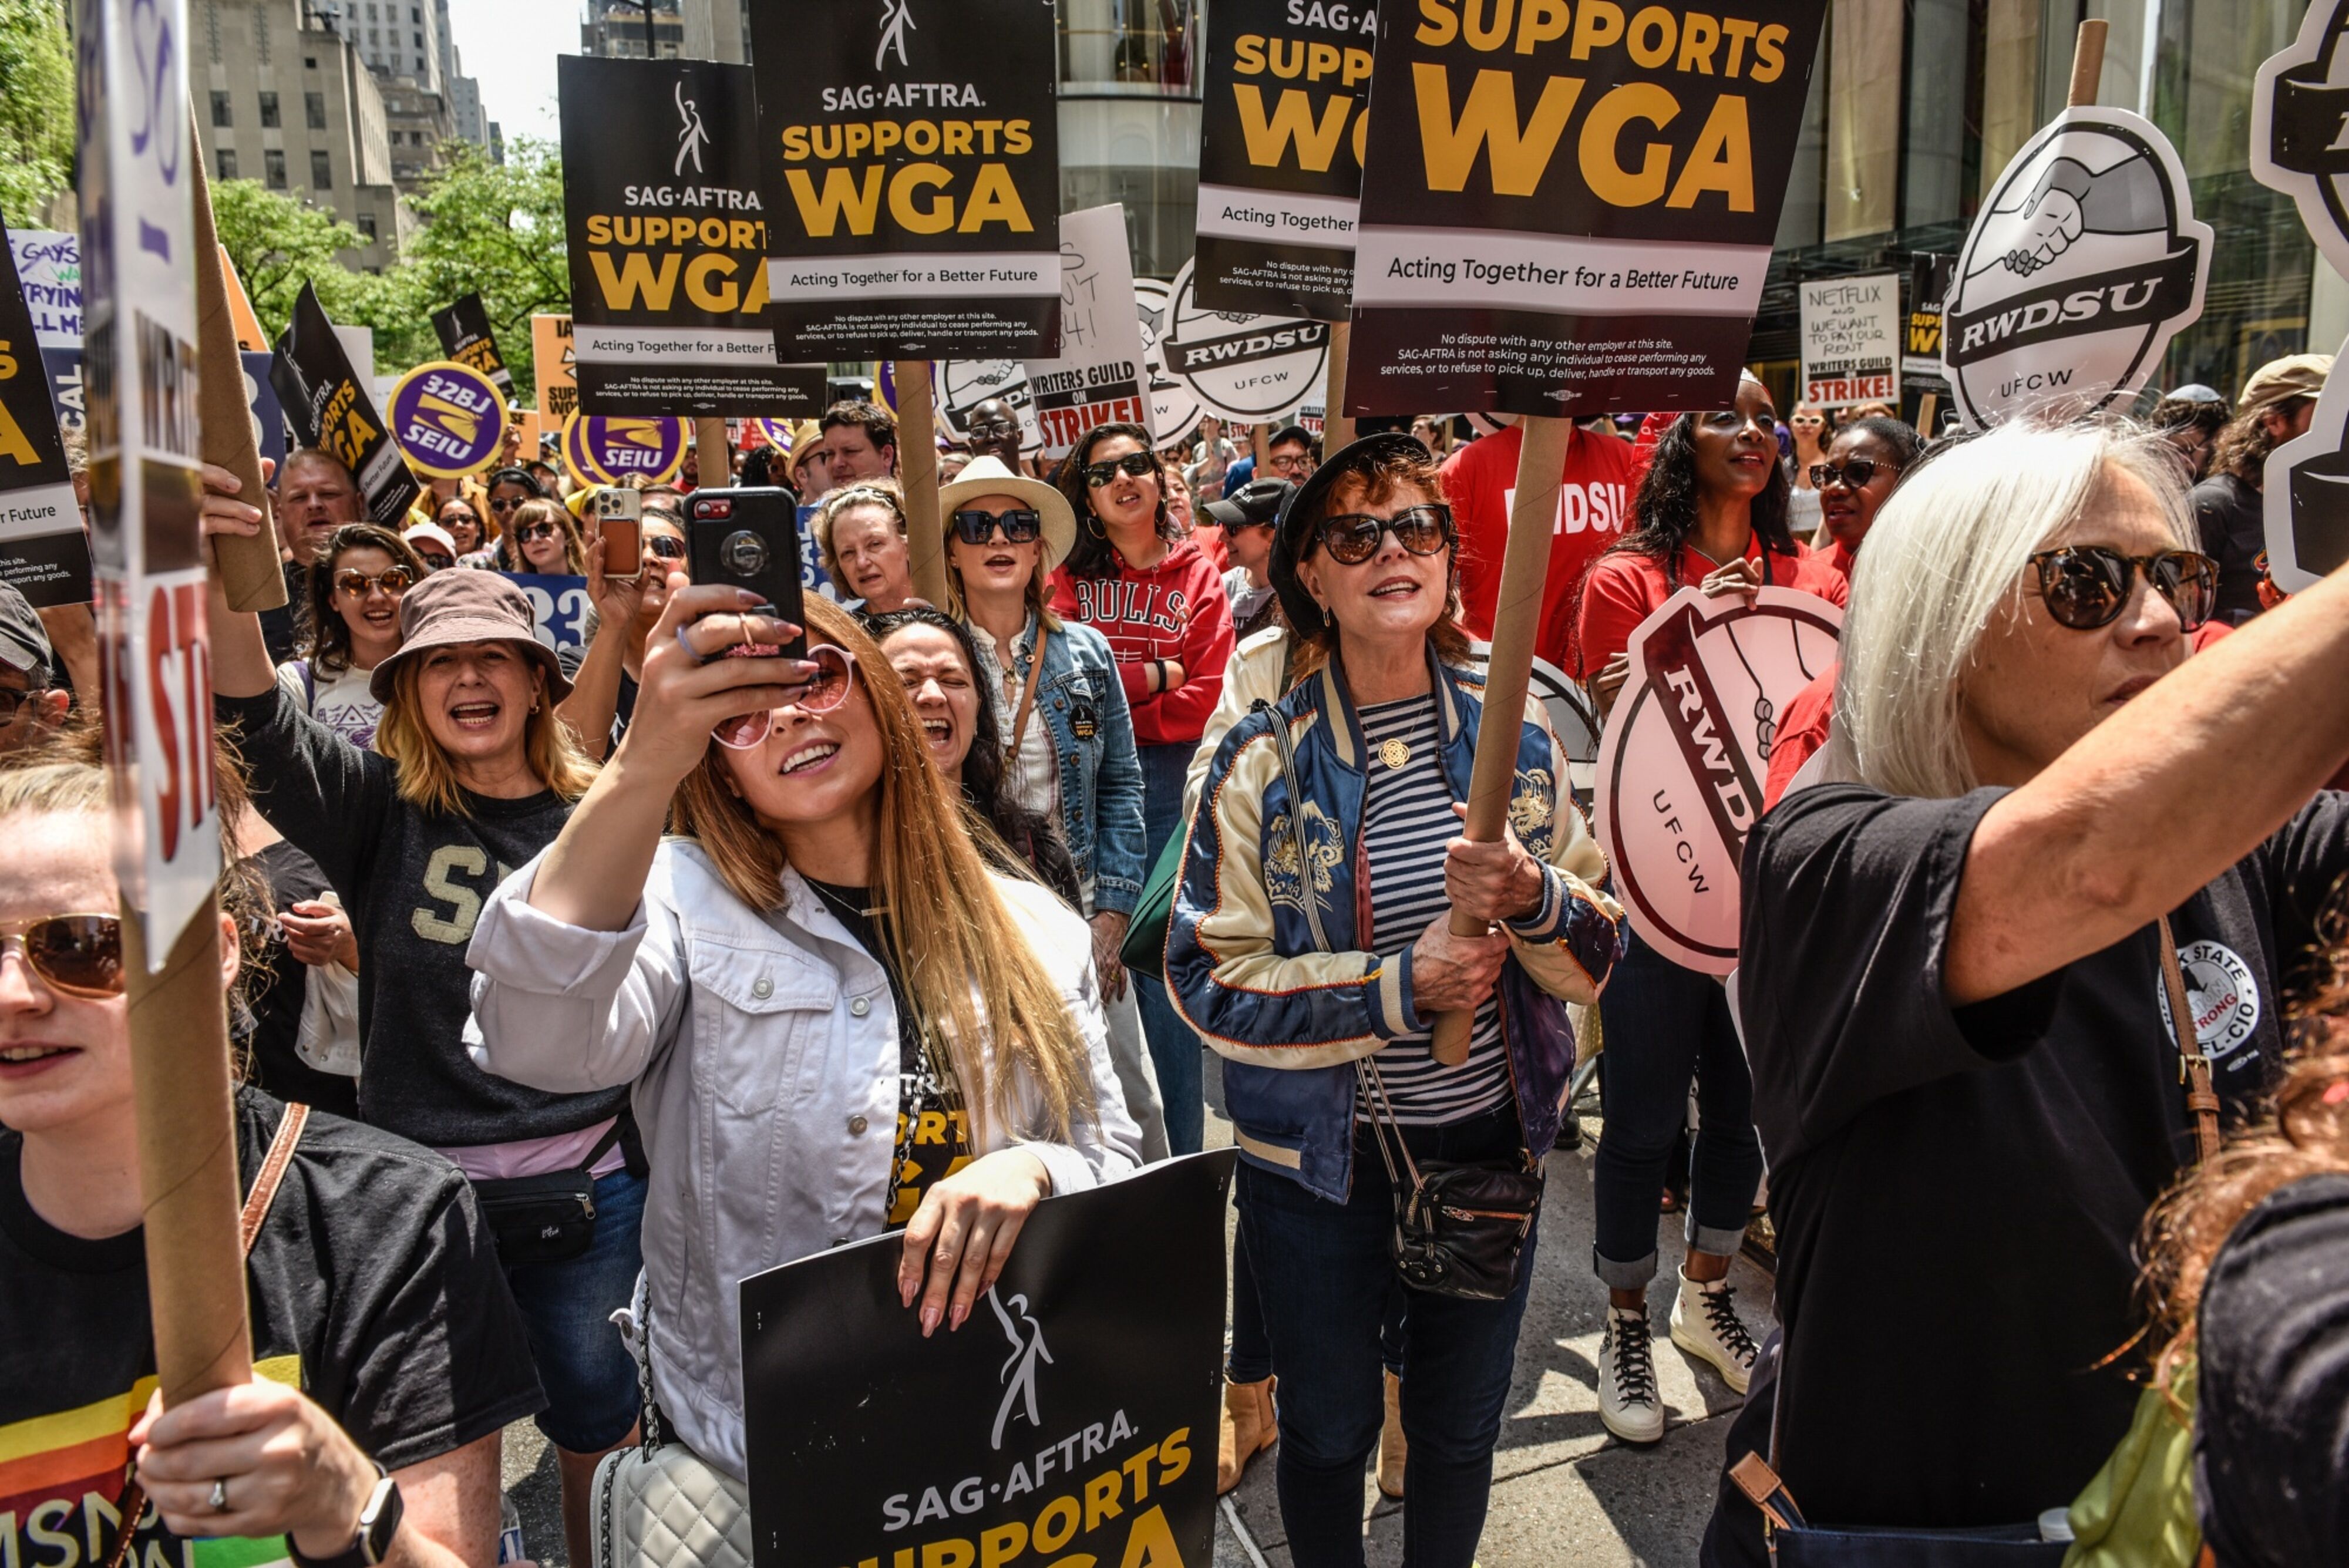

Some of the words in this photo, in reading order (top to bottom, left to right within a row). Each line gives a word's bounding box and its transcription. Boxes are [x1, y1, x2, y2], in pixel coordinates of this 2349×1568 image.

[1414, 0, 1789, 83] SUPPORTS
[1233, 34, 1373, 87] SUPP
[782, 119, 1032, 161] SUPPORTS
[1412, 62, 1754, 213] WGA
[784, 162, 1034, 237] WGA
[587, 215, 766, 250] SUPPORT
[1221, 206, 1275, 227] Acting
[1280, 211, 1354, 231] Together
[790, 273, 837, 287] Acting
[842, 271, 898, 287] Together
[903, 270, 923, 282] for
[927, 272, 935, 282] a
[940, 270, 985, 282] Better
[990, 270, 1038, 281] Future
[1233, 267, 1278, 279] SAG-AFTRA
[1304, 274, 1331, 284] asking
[1334, 277, 1348, 286] any
[1280, 262, 1310, 271] dispute
[1332, 268, 1350, 276] any
[1388, 257, 1456, 284] Acting
[1463, 259, 1569, 285] Together
[1575, 267, 1606, 288] for
[1610, 272, 1620, 288] a
[1626, 270, 1678, 290] Better
[1681, 271, 1738, 290] Future
[1220, 277, 1253, 287] services,
[1276, 281, 1300, 291] refuse
[1313, 284, 1330, 294] pick
[1809, 285, 1881, 307] NETFLIX
[847, 314, 873, 323] dispute
[870, 322, 888, 331] asking
[971, 321, 1012, 329] performing
[1812, 318, 1836, 334] WE
[1839, 315, 1879, 331] WANT
[1960, 277, 2163, 354] RWDSU
[593, 340, 634, 353] Acting
[637, 341, 693, 354] Together
[696, 342, 714, 352] for
[726, 343, 763, 353] Better
[1184, 324, 1324, 366] RWDSU
[1441, 334, 1455, 344] No
[1458, 334, 1496, 346] dispute
[1500, 335, 1526, 346] with
[1530, 339, 1552, 351] any
[1555, 341, 1586, 351] other
[1588, 340, 1626, 352] employer
[1627, 340, 1635, 348] at
[1638, 339, 1654, 348] this
[1655, 338, 1673, 349] site.
[1809, 334, 1828, 345] TO
[1381, 364, 1423, 375] services,
[1425, 365, 1436, 374] or
[1438, 364, 1448, 374] to
[1451, 362, 1481, 373] refuse
[1484, 363, 1495, 373] to
[1499, 362, 1524, 375] pick
[1527, 368, 1545, 378] up,
[1549, 368, 1587, 379] deliver,
[1589, 366, 1615, 378] handle
[1617, 367, 1626, 375] or
[1627, 366, 1668, 377] transport
[1670, 367, 1686, 377] any
[1687, 366, 1715, 377] goods.
[1398, 349, 1455, 359] SAG-AFTRA
[1458, 348, 1465, 358] is
[1468, 349, 1485, 359] not
[1488, 349, 1527, 363] asking
[1530, 353, 1553, 365] any
[1556, 353, 1603, 365] individual
[1605, 354, 1613, 364] to
[1614, 355, 1637, 363] cease
[1638, 352, 1688, 364] performing
[1690, 354, 1706, 365] any
[1809, 359, 1856, 372] WRITERS
[1859, 356, 1892, 369] GUILD
[421, 374, 493, 413] 32BJ
[1030, 369, 1084, 395] WRITERS
[1088, 361, 1135, 385] GUILD
[1234, 372, 1288, 390] UFCW
[1809, 376, 1893, 403] STRIKE!
[2001, 368, 2074, 398] UFCW
[56, 364, 87, 433] CAL
[1072, 389, 1087, 405] ON
[334, 409, 378, 470] GA
[403, 423, 472, 460] SEIU
[604, 449, 662, 467] SEIU
[9, 506, 56, 522] Future
[1504, 482, 1626, 535] DSU
[1076, 578, 1186, 632] BULLS
[1664, 664, 1755, 844] RWD
[1653, 789, 1709, 894] UFCW
[2194, 945, 2247, 981] STATE
[2194, 993, 2237, 1034] TRONG
[2200, 1002, 2254, 1054] FL-CIO
